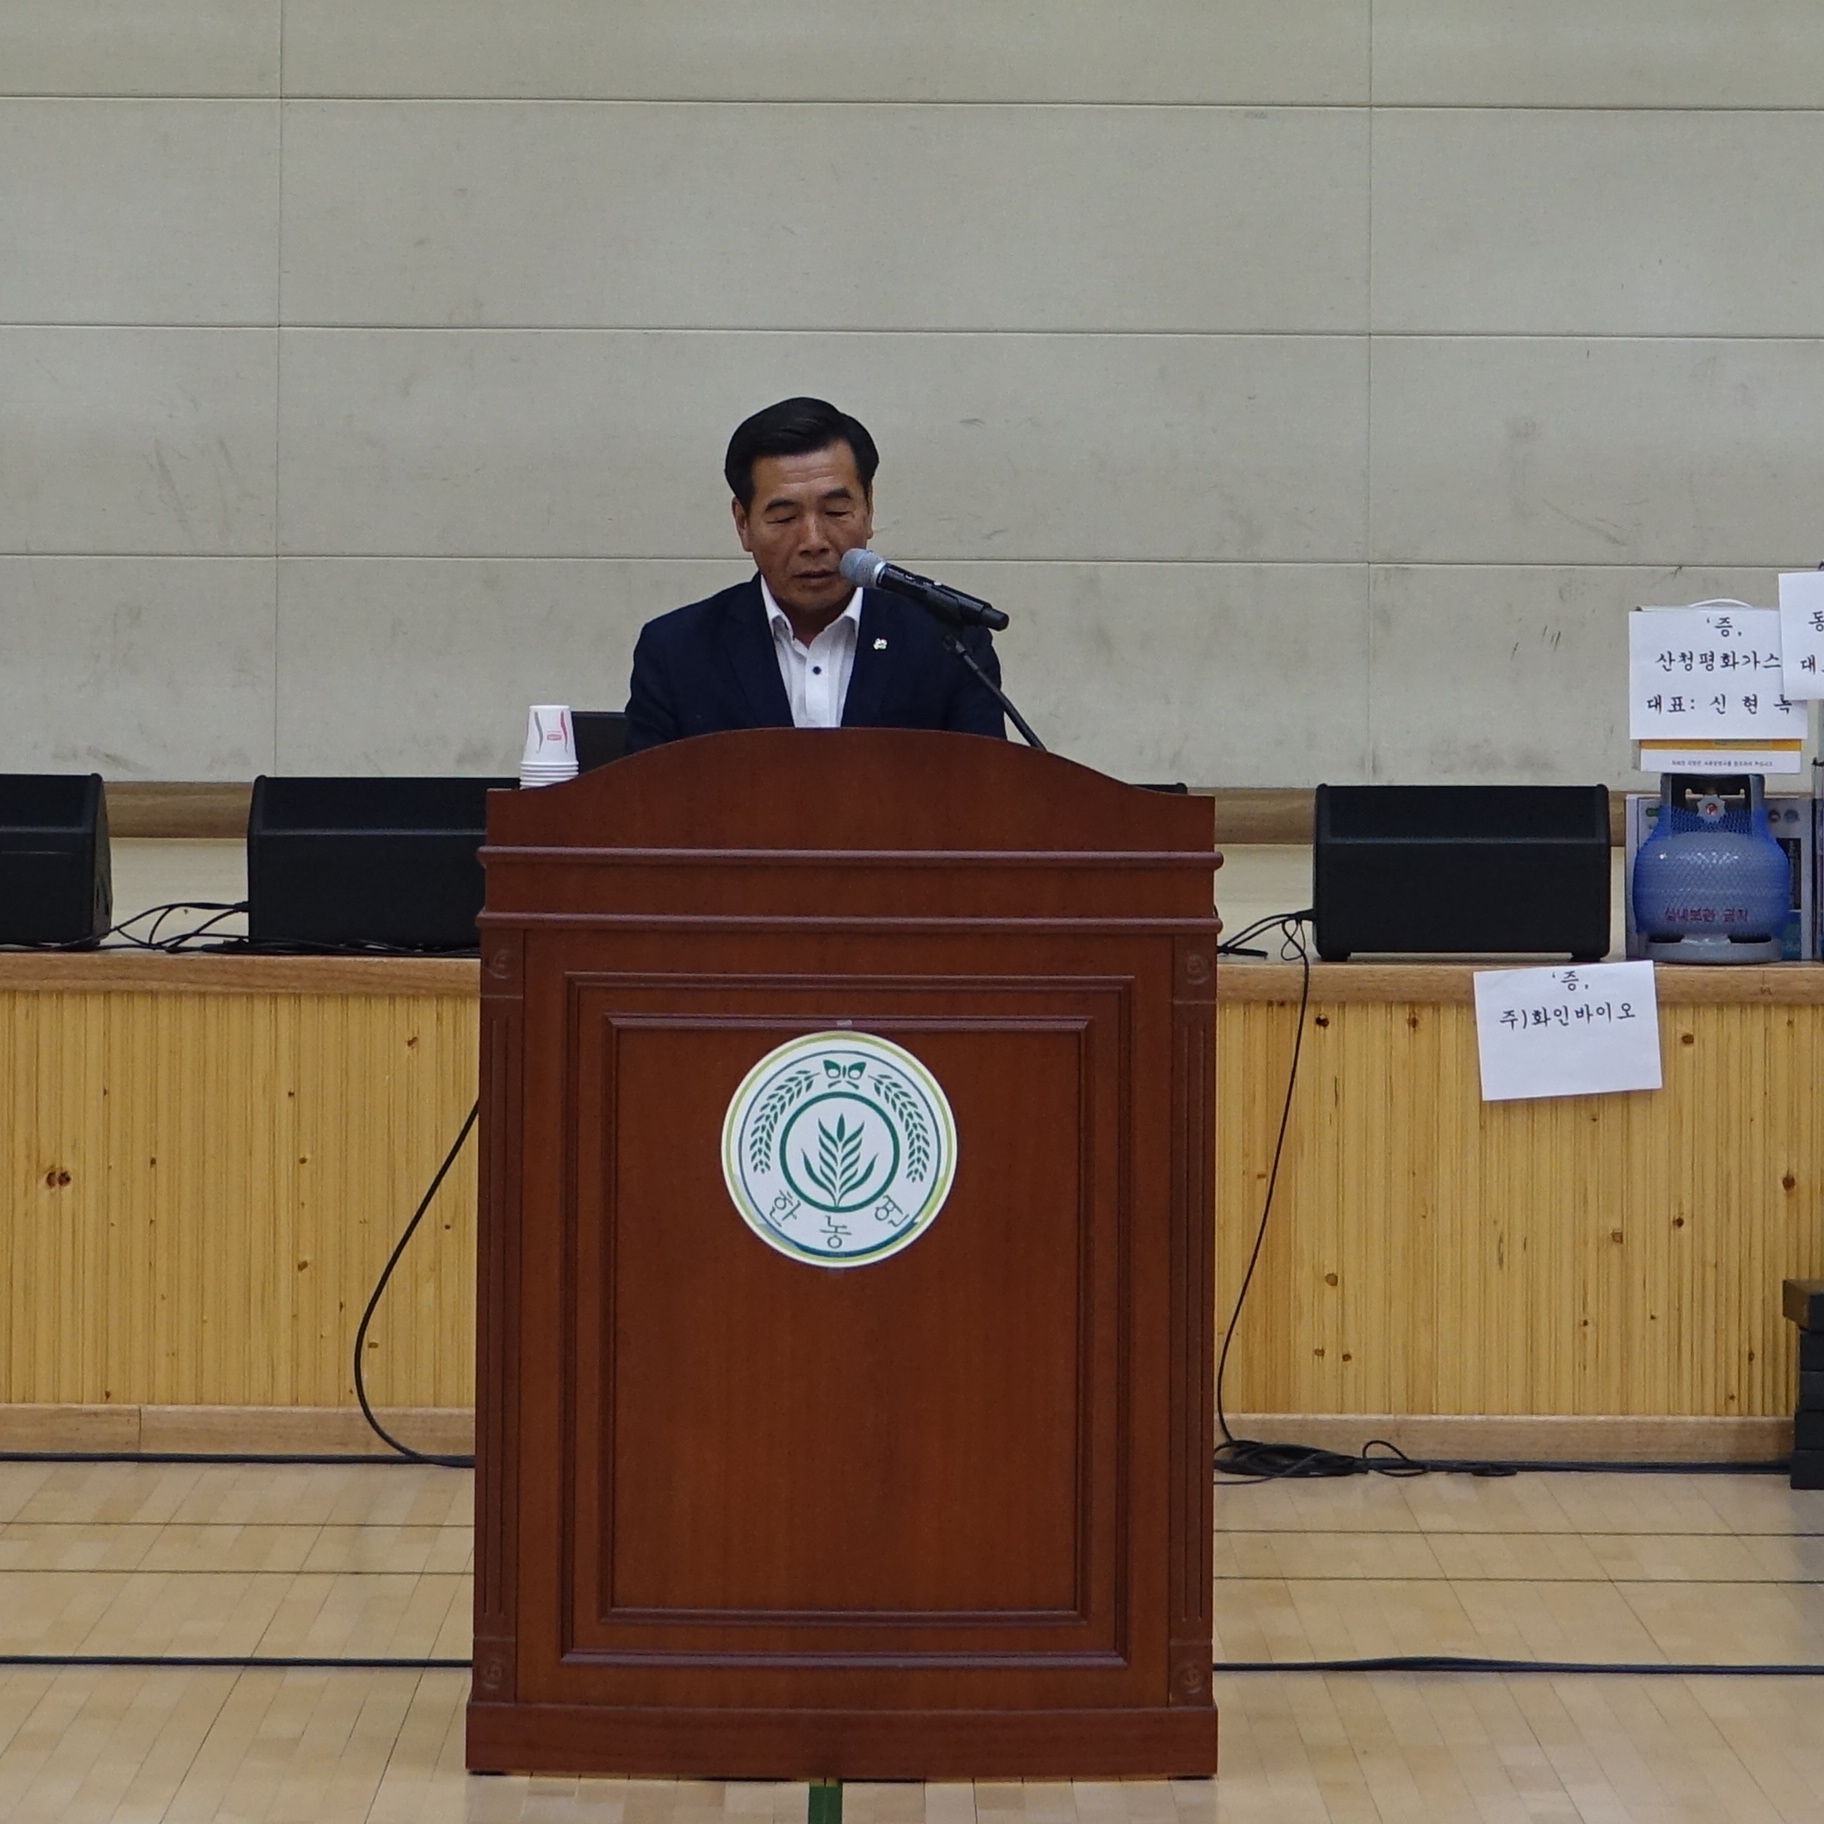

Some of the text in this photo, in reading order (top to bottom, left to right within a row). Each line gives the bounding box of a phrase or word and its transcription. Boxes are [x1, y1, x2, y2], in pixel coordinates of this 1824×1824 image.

[1655, 650, 1782, 673] 산청평화가스
[1646, 694, 1696, 713] 대표:
[1499, 1001, 1636, 1030] 주)화인바이오
[769, 1188, 909, 1249] 한농연
